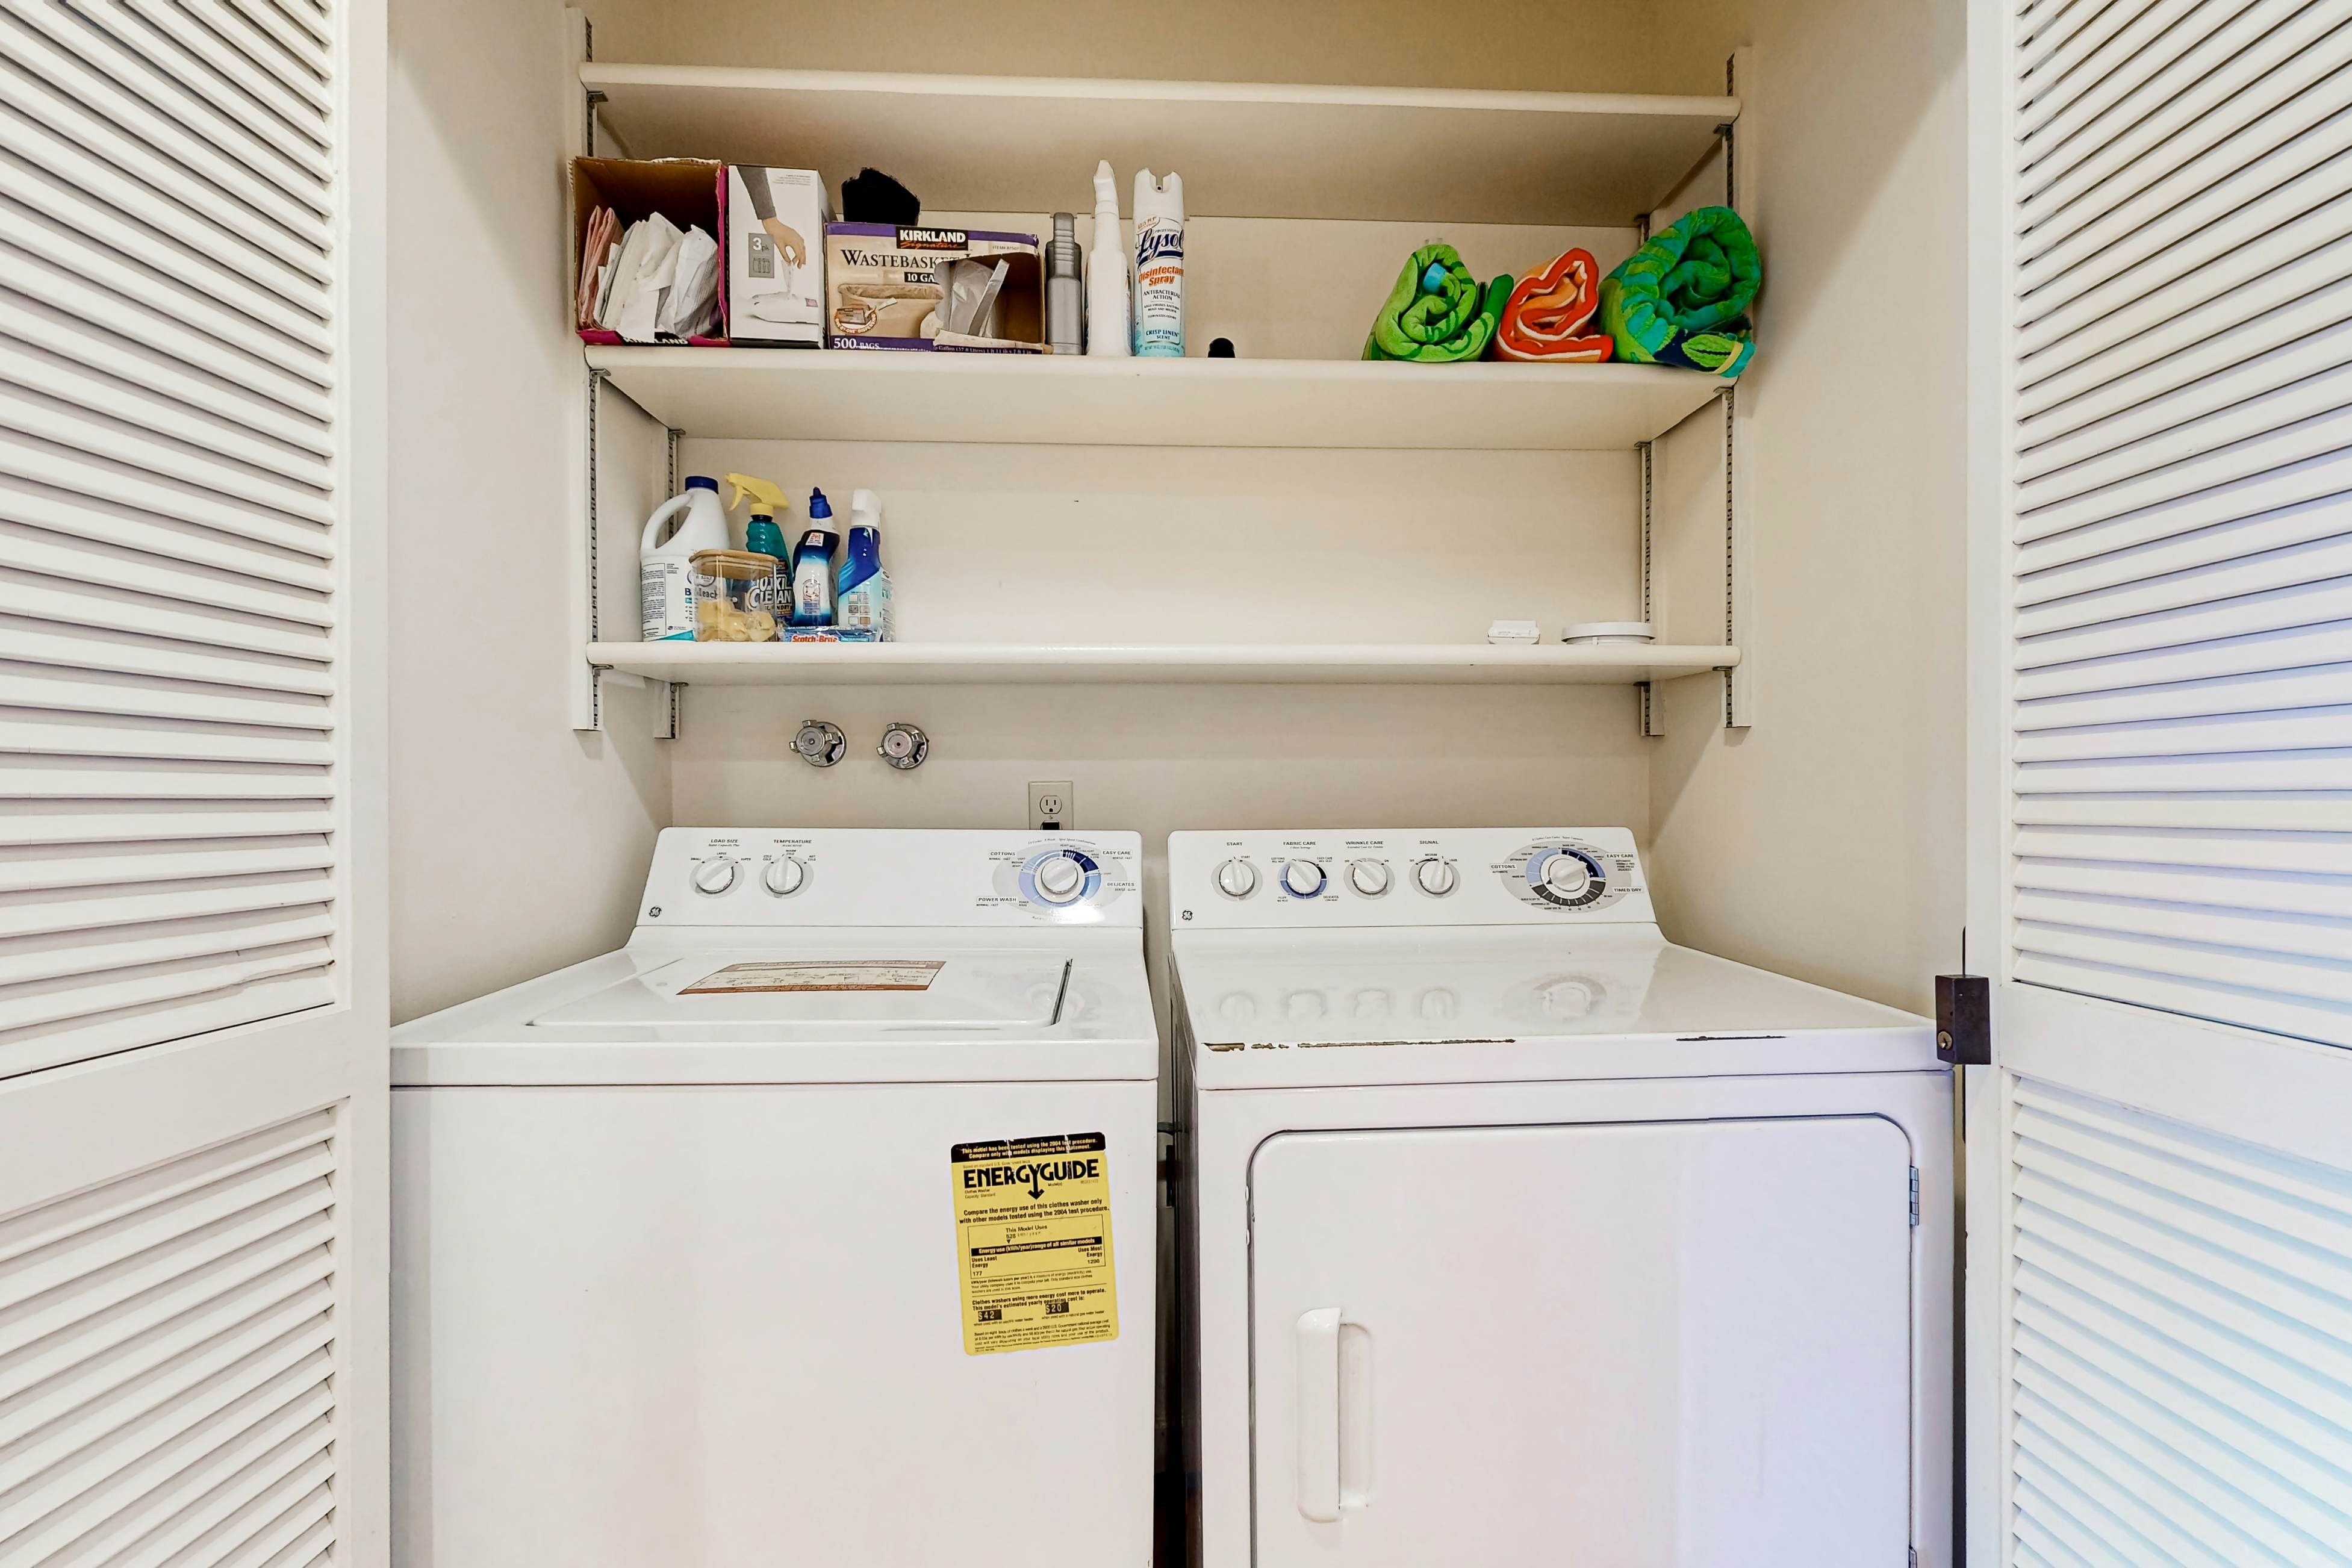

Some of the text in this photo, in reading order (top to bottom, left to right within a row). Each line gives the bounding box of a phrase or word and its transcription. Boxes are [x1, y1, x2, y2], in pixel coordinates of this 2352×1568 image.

[900, 229, 966, 243] KIRKLAND
[753, 237, 762, 250] 3
[900, 240, 965, 250] Signature
[1136, 228, 1184, 263] Lysol
[907, 273, 918, 282] 10
[1149, 275, 1175, 287] Spray
[1143, 289, 1180, 299] ANTIBACTERIAL
[833, 338, 857, 349] 500
[963, 1159, 1100, 1189] ENERGYGUIDE
